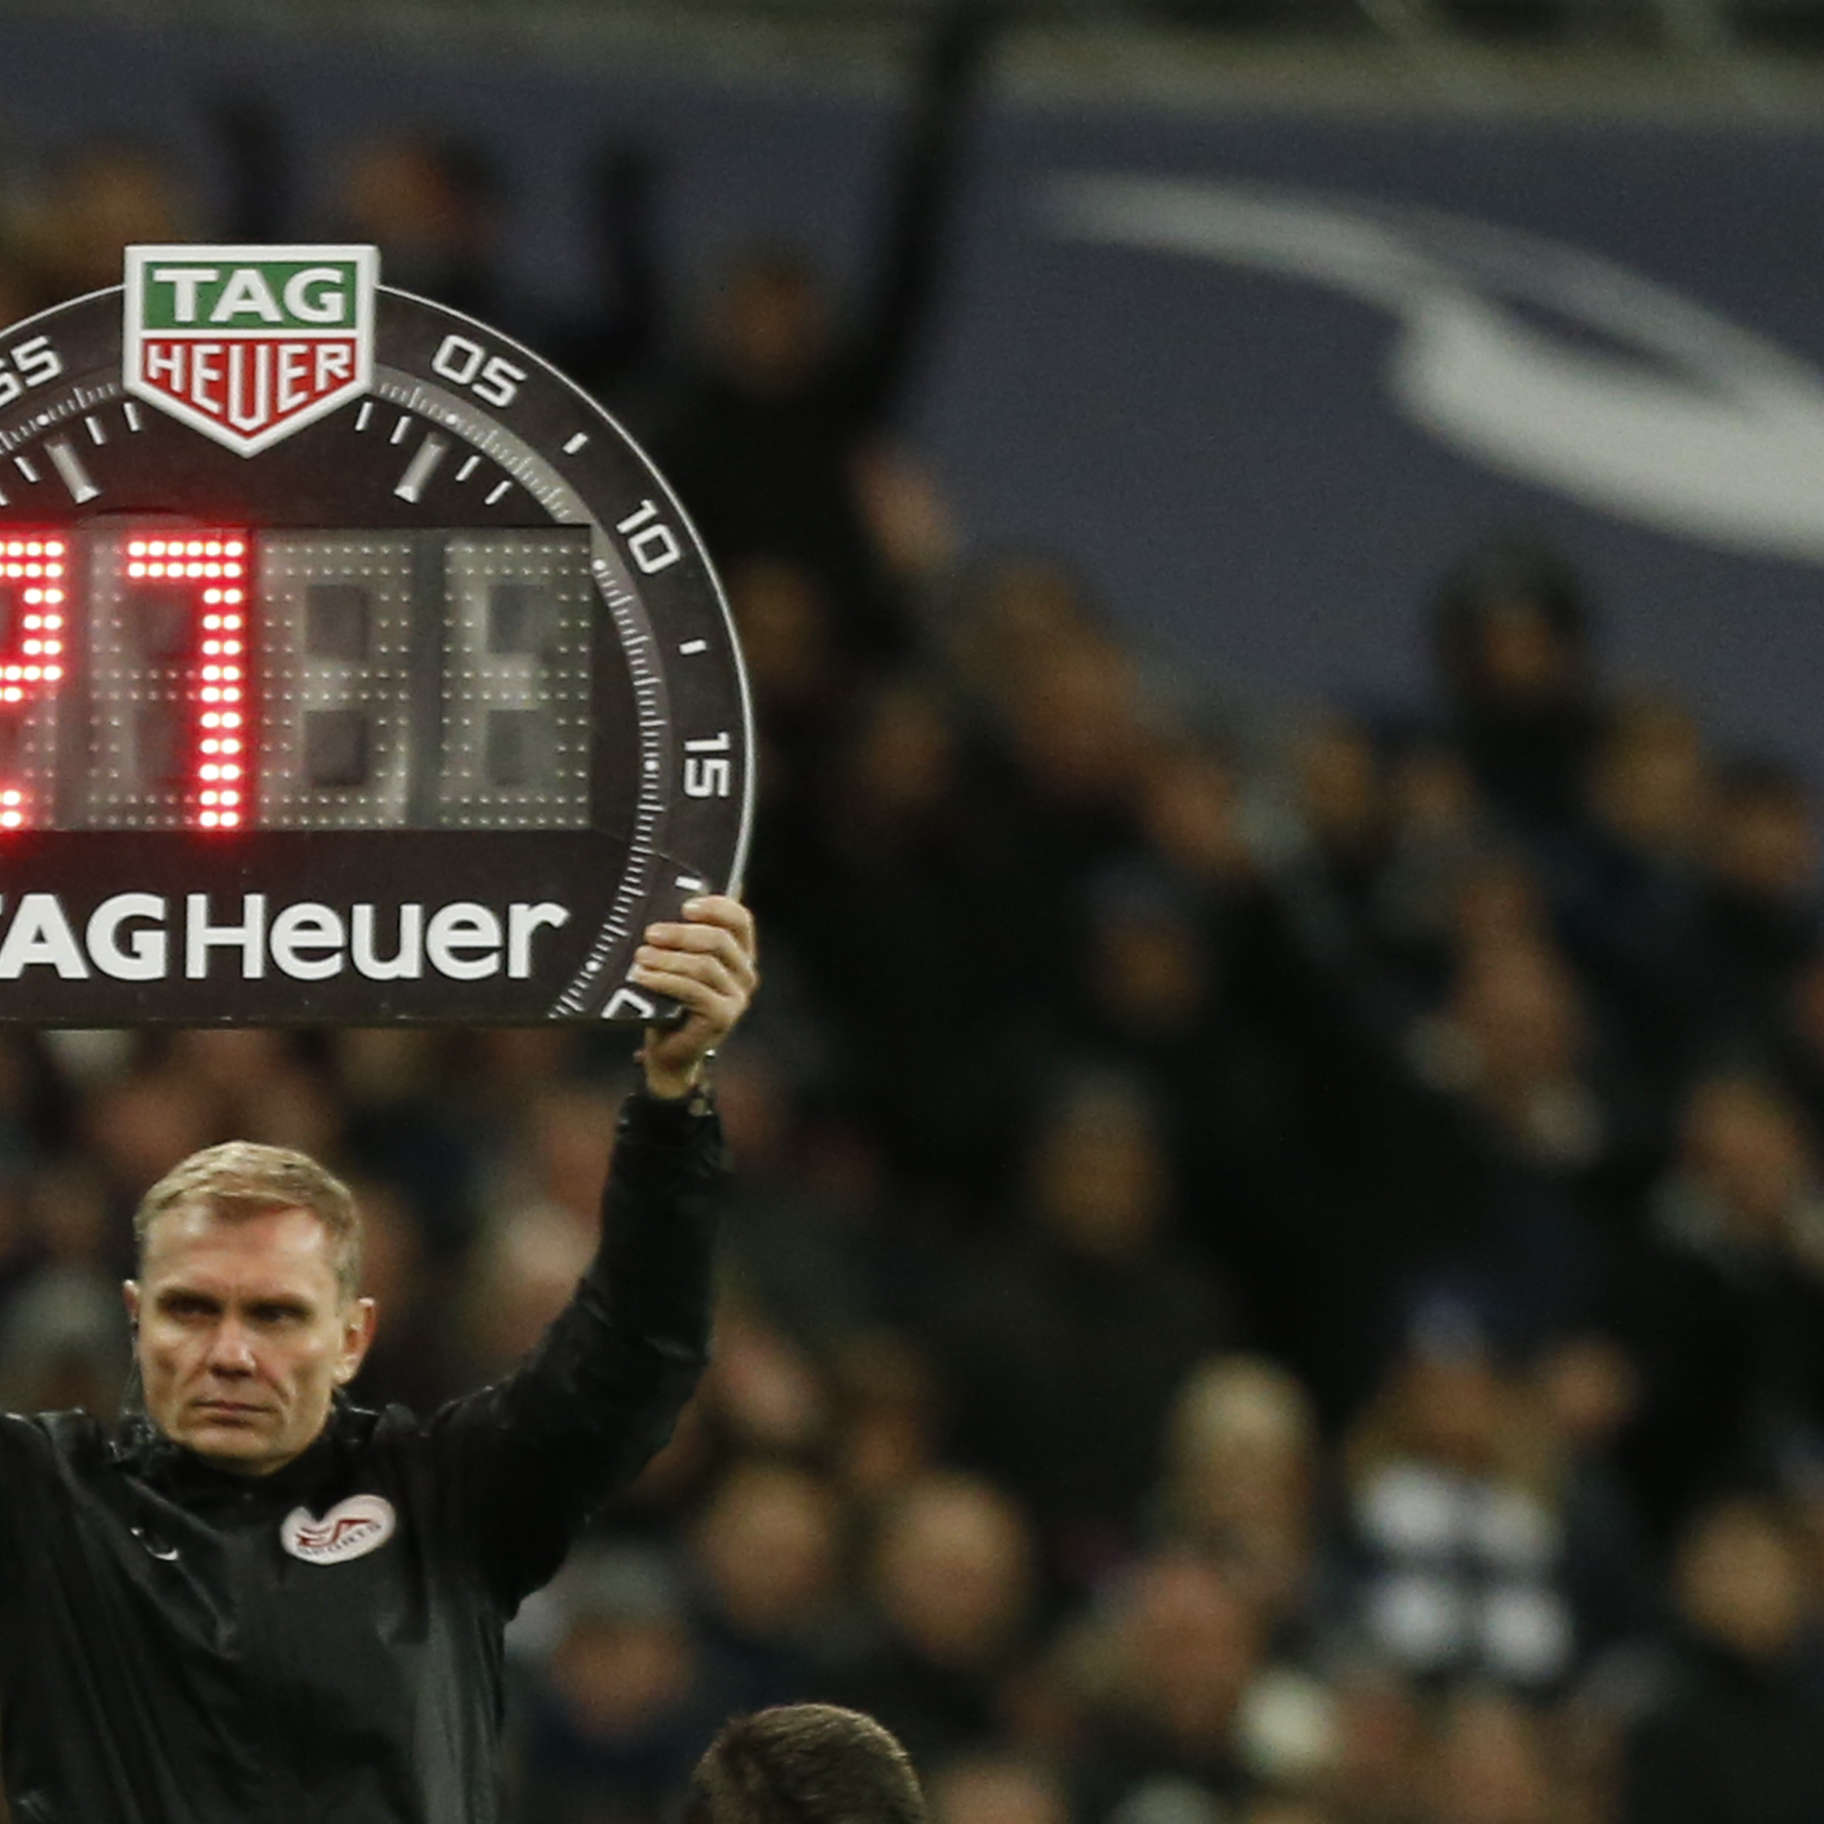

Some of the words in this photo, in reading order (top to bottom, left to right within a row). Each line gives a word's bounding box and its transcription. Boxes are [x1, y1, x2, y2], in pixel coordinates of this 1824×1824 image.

[153, 267, 345, 322] TAG
[148, 344, 351, 431] HEUER
[431, 335, 527, 407] 05
[614, 498, 684, 575] 10
[683, 731, 729, 798] 15
